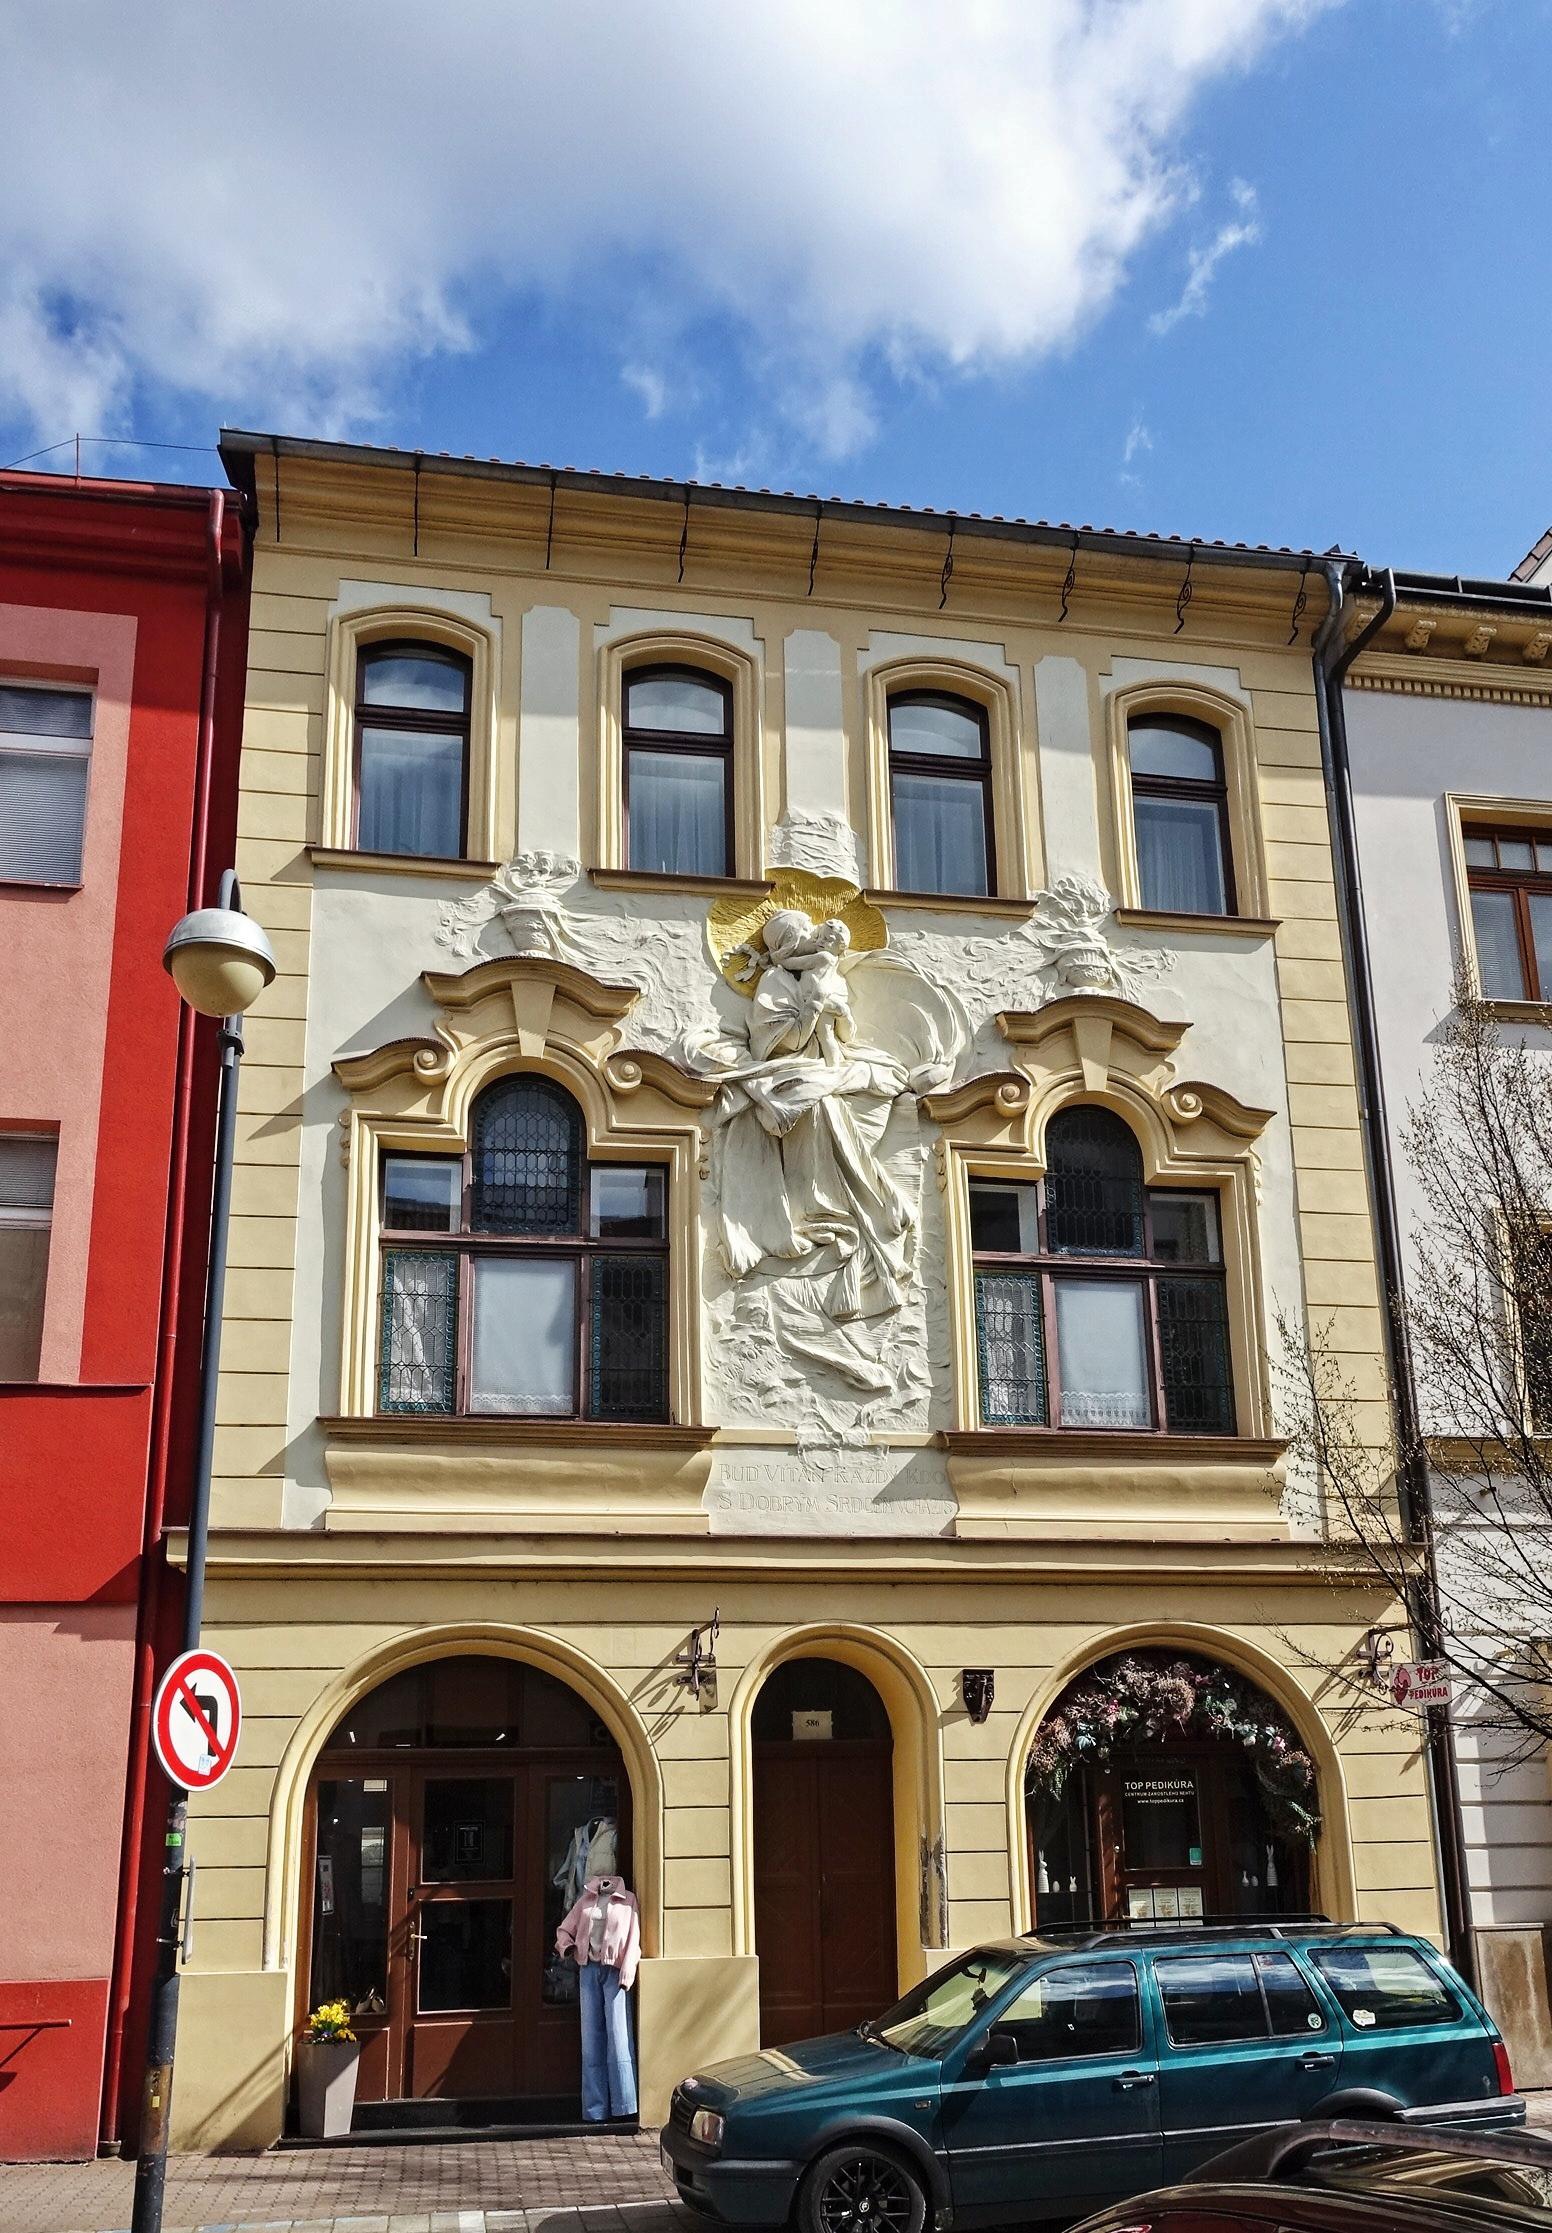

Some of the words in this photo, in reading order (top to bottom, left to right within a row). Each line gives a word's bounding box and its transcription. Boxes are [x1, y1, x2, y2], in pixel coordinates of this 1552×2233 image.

[718, 1490, 732, 1510] S
[805, 1719, 820, 1727] 586
[1124, 1781, 1144, 1790] TOP
[1145, 1778, 1194, 1790] PEDIKÚRA
